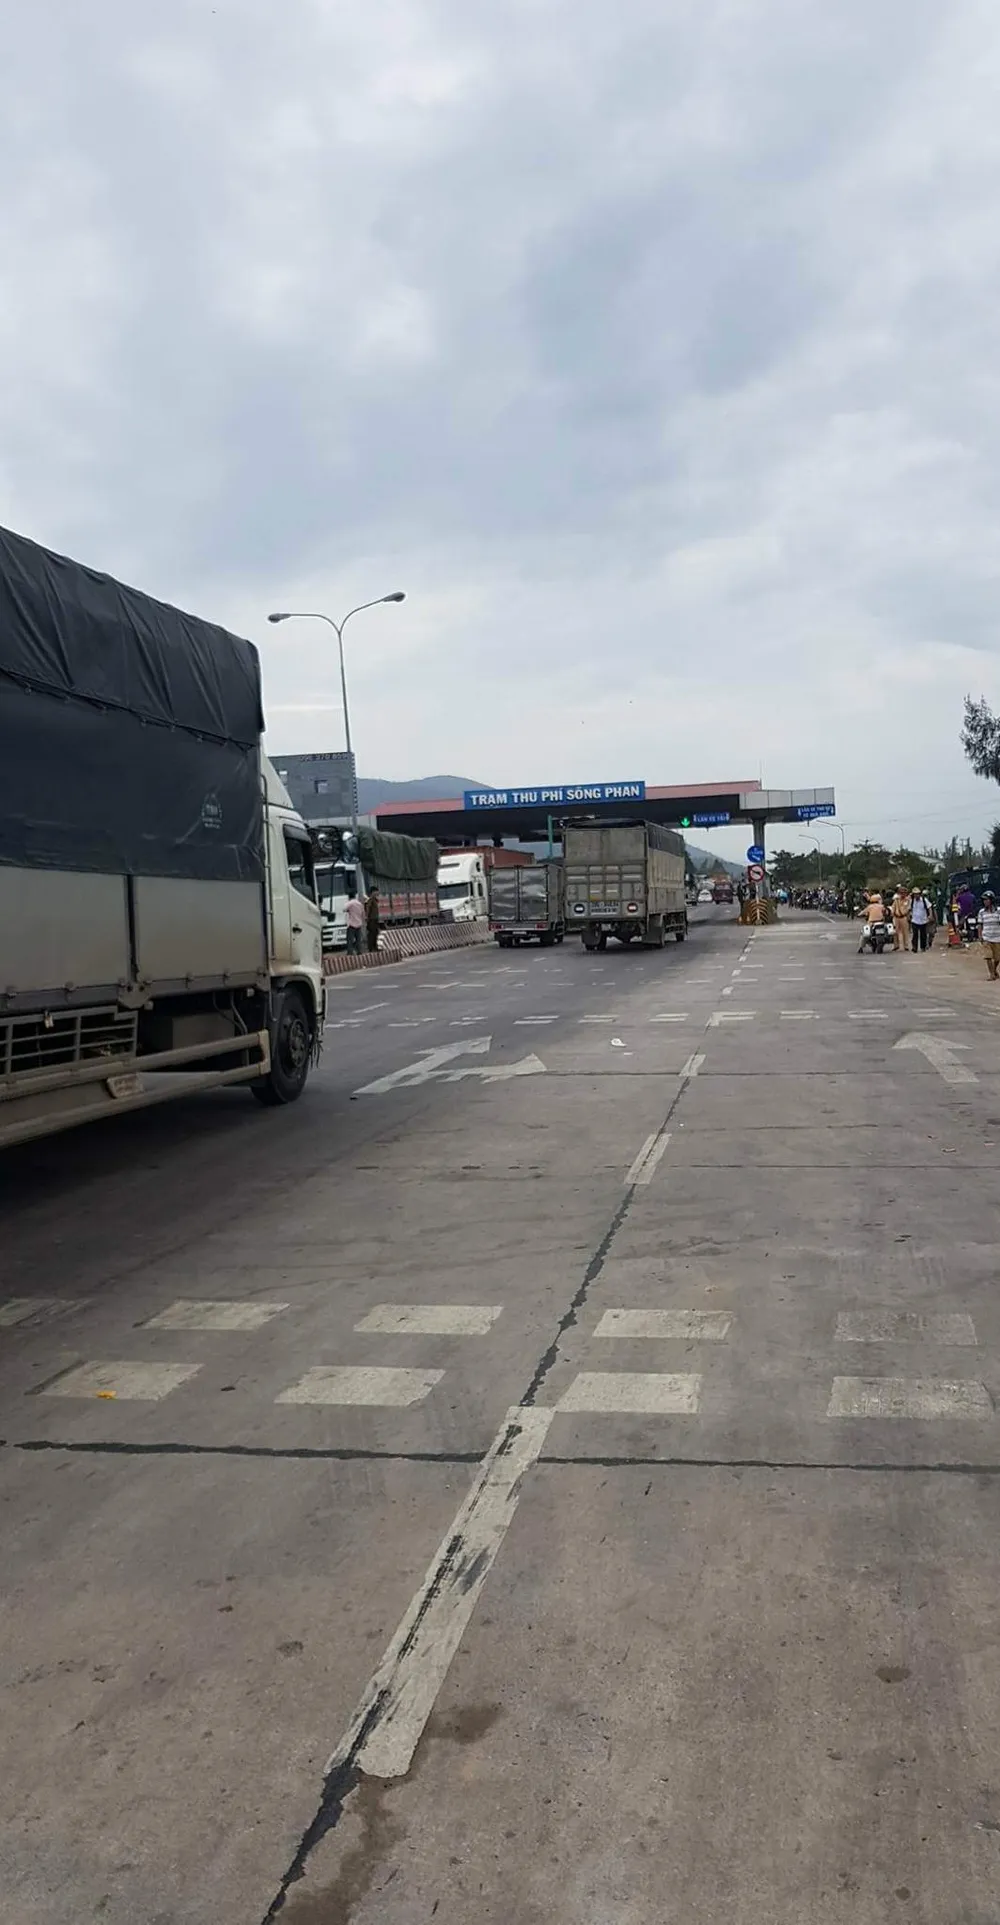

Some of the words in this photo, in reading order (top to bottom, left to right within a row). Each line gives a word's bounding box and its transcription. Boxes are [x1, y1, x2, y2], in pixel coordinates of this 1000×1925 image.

[471, 792, 508, 807] TRẠM
[511, 790, 538, 803] THU
[541, 787, 563, 801] PHÍ
[566, 785, 601, 801] SÔNG
[604, 784, 640, 798] PHAN
